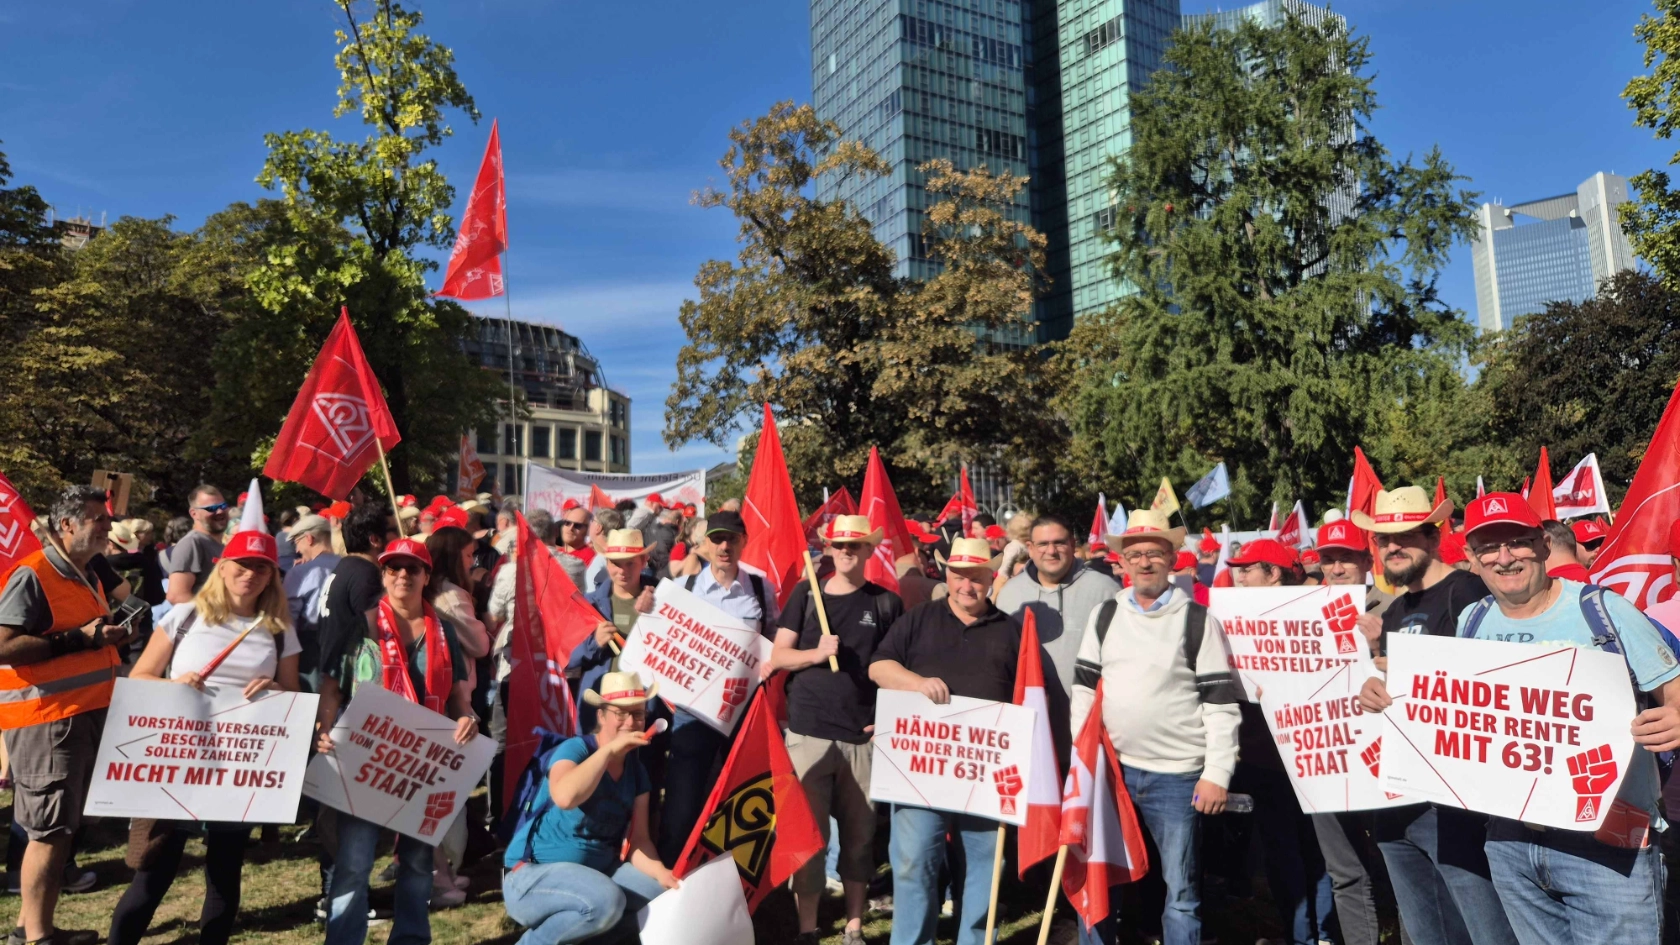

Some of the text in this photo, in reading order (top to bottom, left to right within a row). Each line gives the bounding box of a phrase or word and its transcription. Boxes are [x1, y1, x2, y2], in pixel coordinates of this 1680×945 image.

[659, 603, 759, 669] ZUSAMMENHALT
[1222, 615, 1324, 637] HÄNDE WEG
[642, 631, 716, 681] STÄRKSTE
[668, 626, 734, 671] IST UNSERE
[1227, 654, 1358, 672] ALTERSTEILZEI
[1253, 639, 1286, 653] VON
[1290, 640, 1322, 655] DER
[643, 654, 695, 692] MARKE.
[1274, 695, 1364, 729] HÄNDE WEG
[1411, 670, 1595, 722] HÄNDE WEG
[129, 716, 290, 739] VORSTÄNDE VERSAGEN,
[160, 732, 265, 750] BESCHÄFTIGTE
[896, 715, 1010, 750] HÄNDE WEG
[1275, 721, 1362, 752] VOM SOZIAL-
[1404, 702, 1581, 746] VON DER RENTE
[144, 745, 259, 763] SOLLEN ZAHLEN?
[349, 731, 446, 786] VOM SOZIAL-
[361, 712, 466, 772] HÄNDE WEG
[893, 738, 1001, 764] VON DER RENTE
[1434, 729, 1554, 775] MIT 63!
[106, 762, 286, 789] NICHT MIT UNS!
[910, 755, 985, 782] MIT 63!
[1295, 748, 1348, 778] STAAT
[354, 762, 422, 802] STAAT
